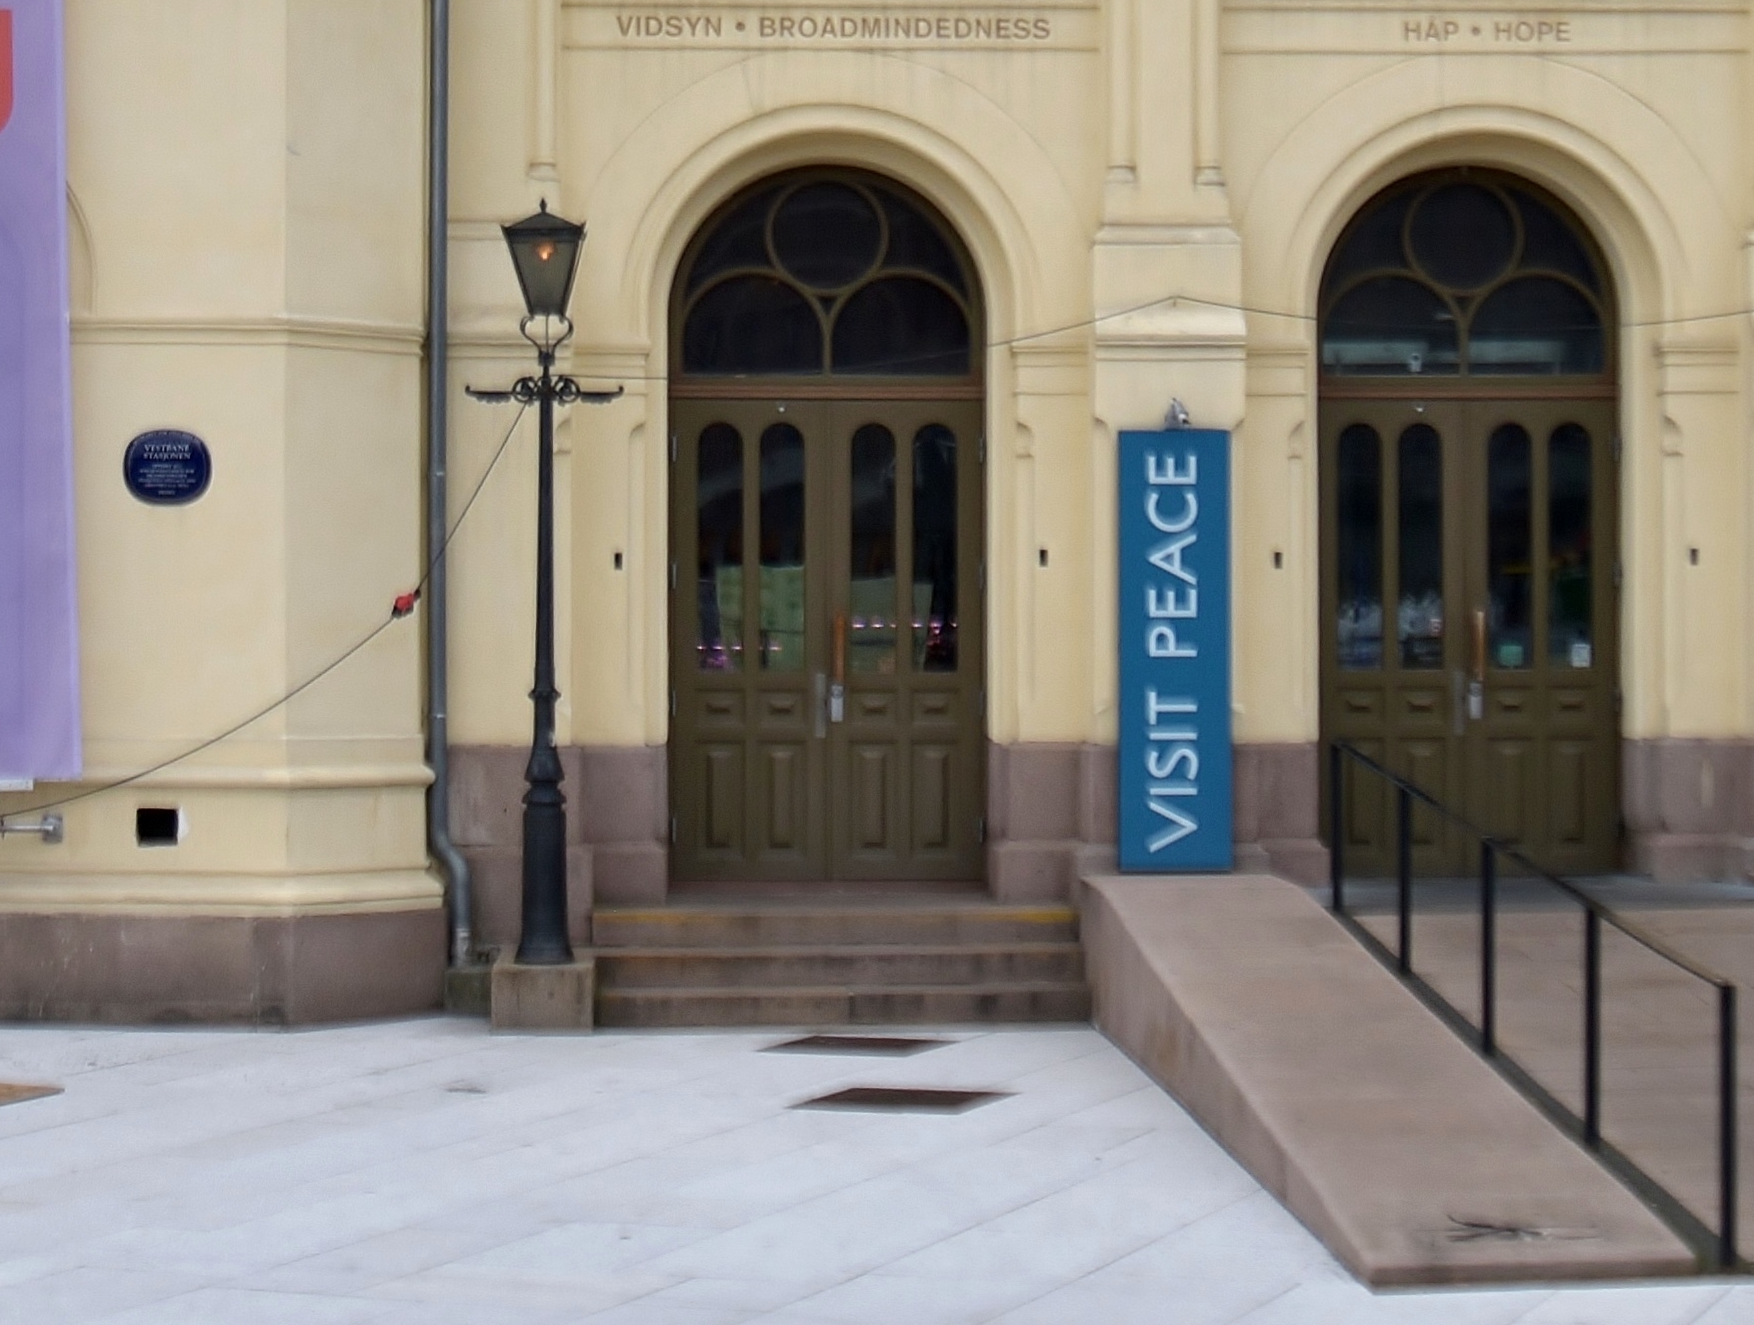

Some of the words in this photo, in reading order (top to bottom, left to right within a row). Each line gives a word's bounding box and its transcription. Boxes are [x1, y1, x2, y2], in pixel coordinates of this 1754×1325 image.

[615, 15, 723, 38] VIDSYN
[758, 16, 1052, 40] BROADMINDEDNESS
[1403, 15, 1460, 42] HÅP
[1494, 20, 1572, 42] HOPE
[1147, 454, 1199, 658] PEACE
[1148, 690, 1199, 853] VISIT
